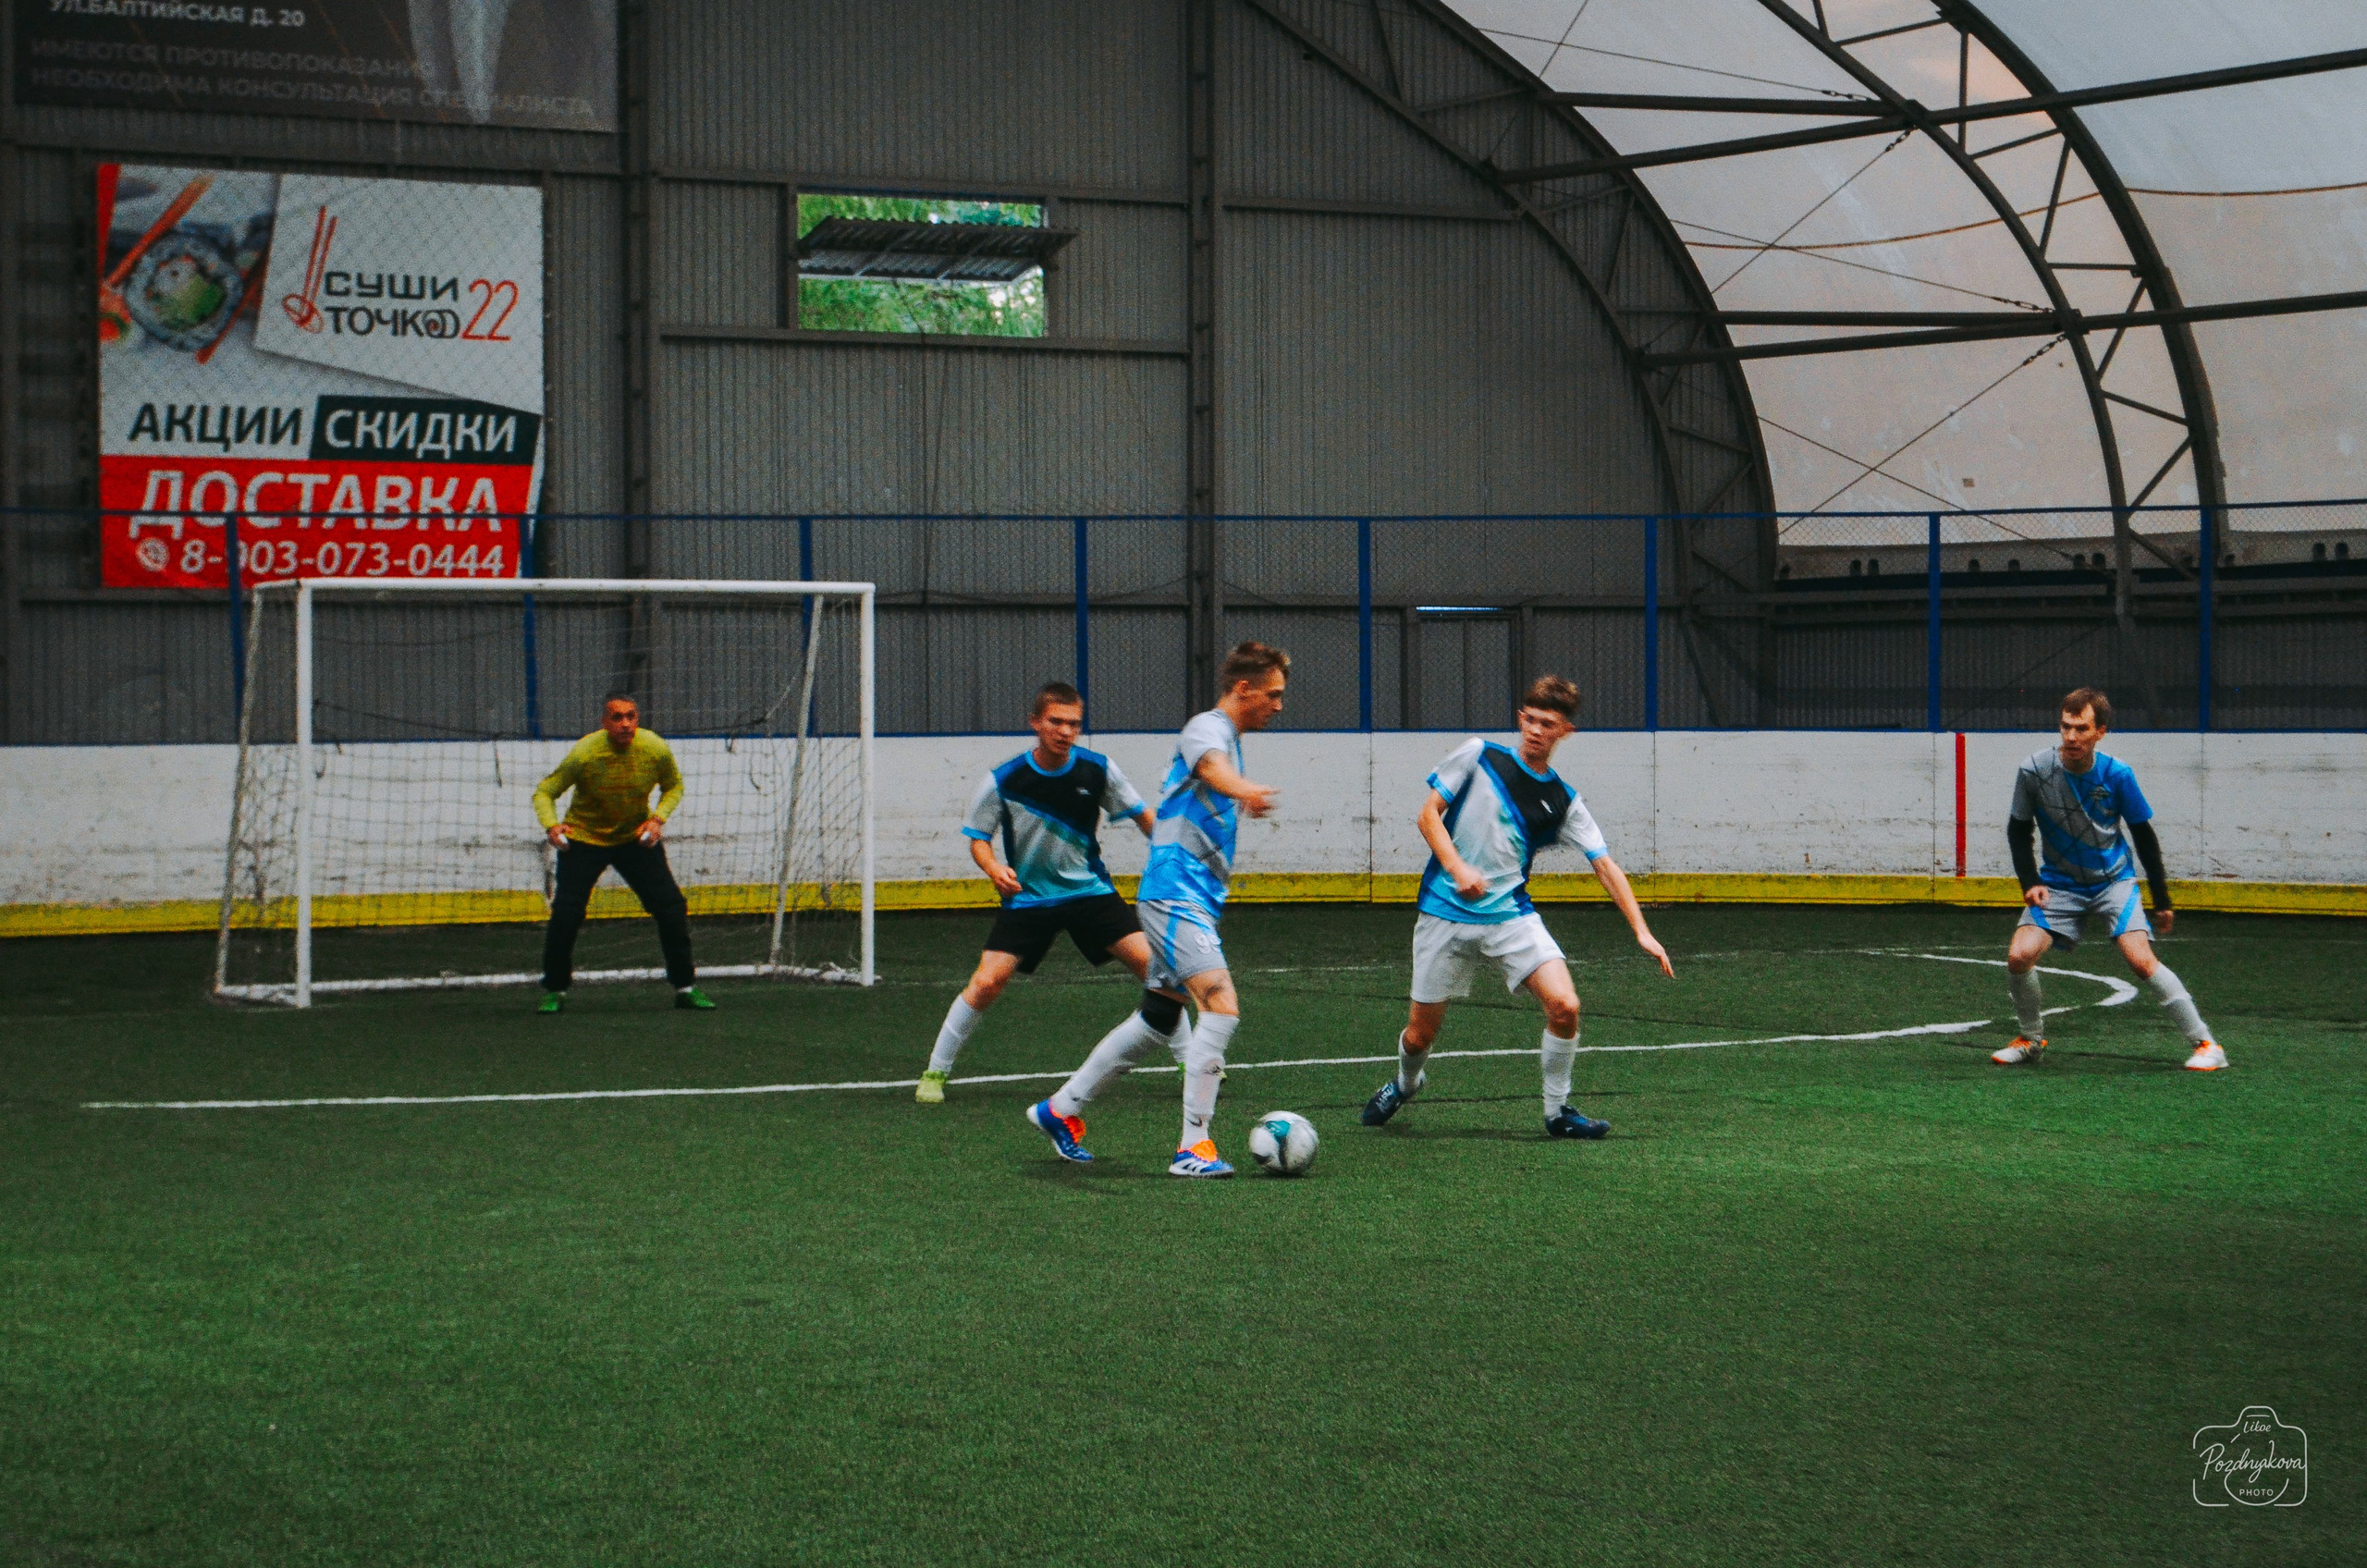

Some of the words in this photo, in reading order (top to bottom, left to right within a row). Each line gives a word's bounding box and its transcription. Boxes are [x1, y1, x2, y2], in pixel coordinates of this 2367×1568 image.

[278, 8, 306, 27] 20
[325, 271, 460, 302] СУШИ
[461, 277, 520, 341] 22
[129, 402, 302, 451] АКЦИИ
[325, 409, 517, 459] СКИДКИ
[129, 469, 503, 540] ДОСТАВКА
